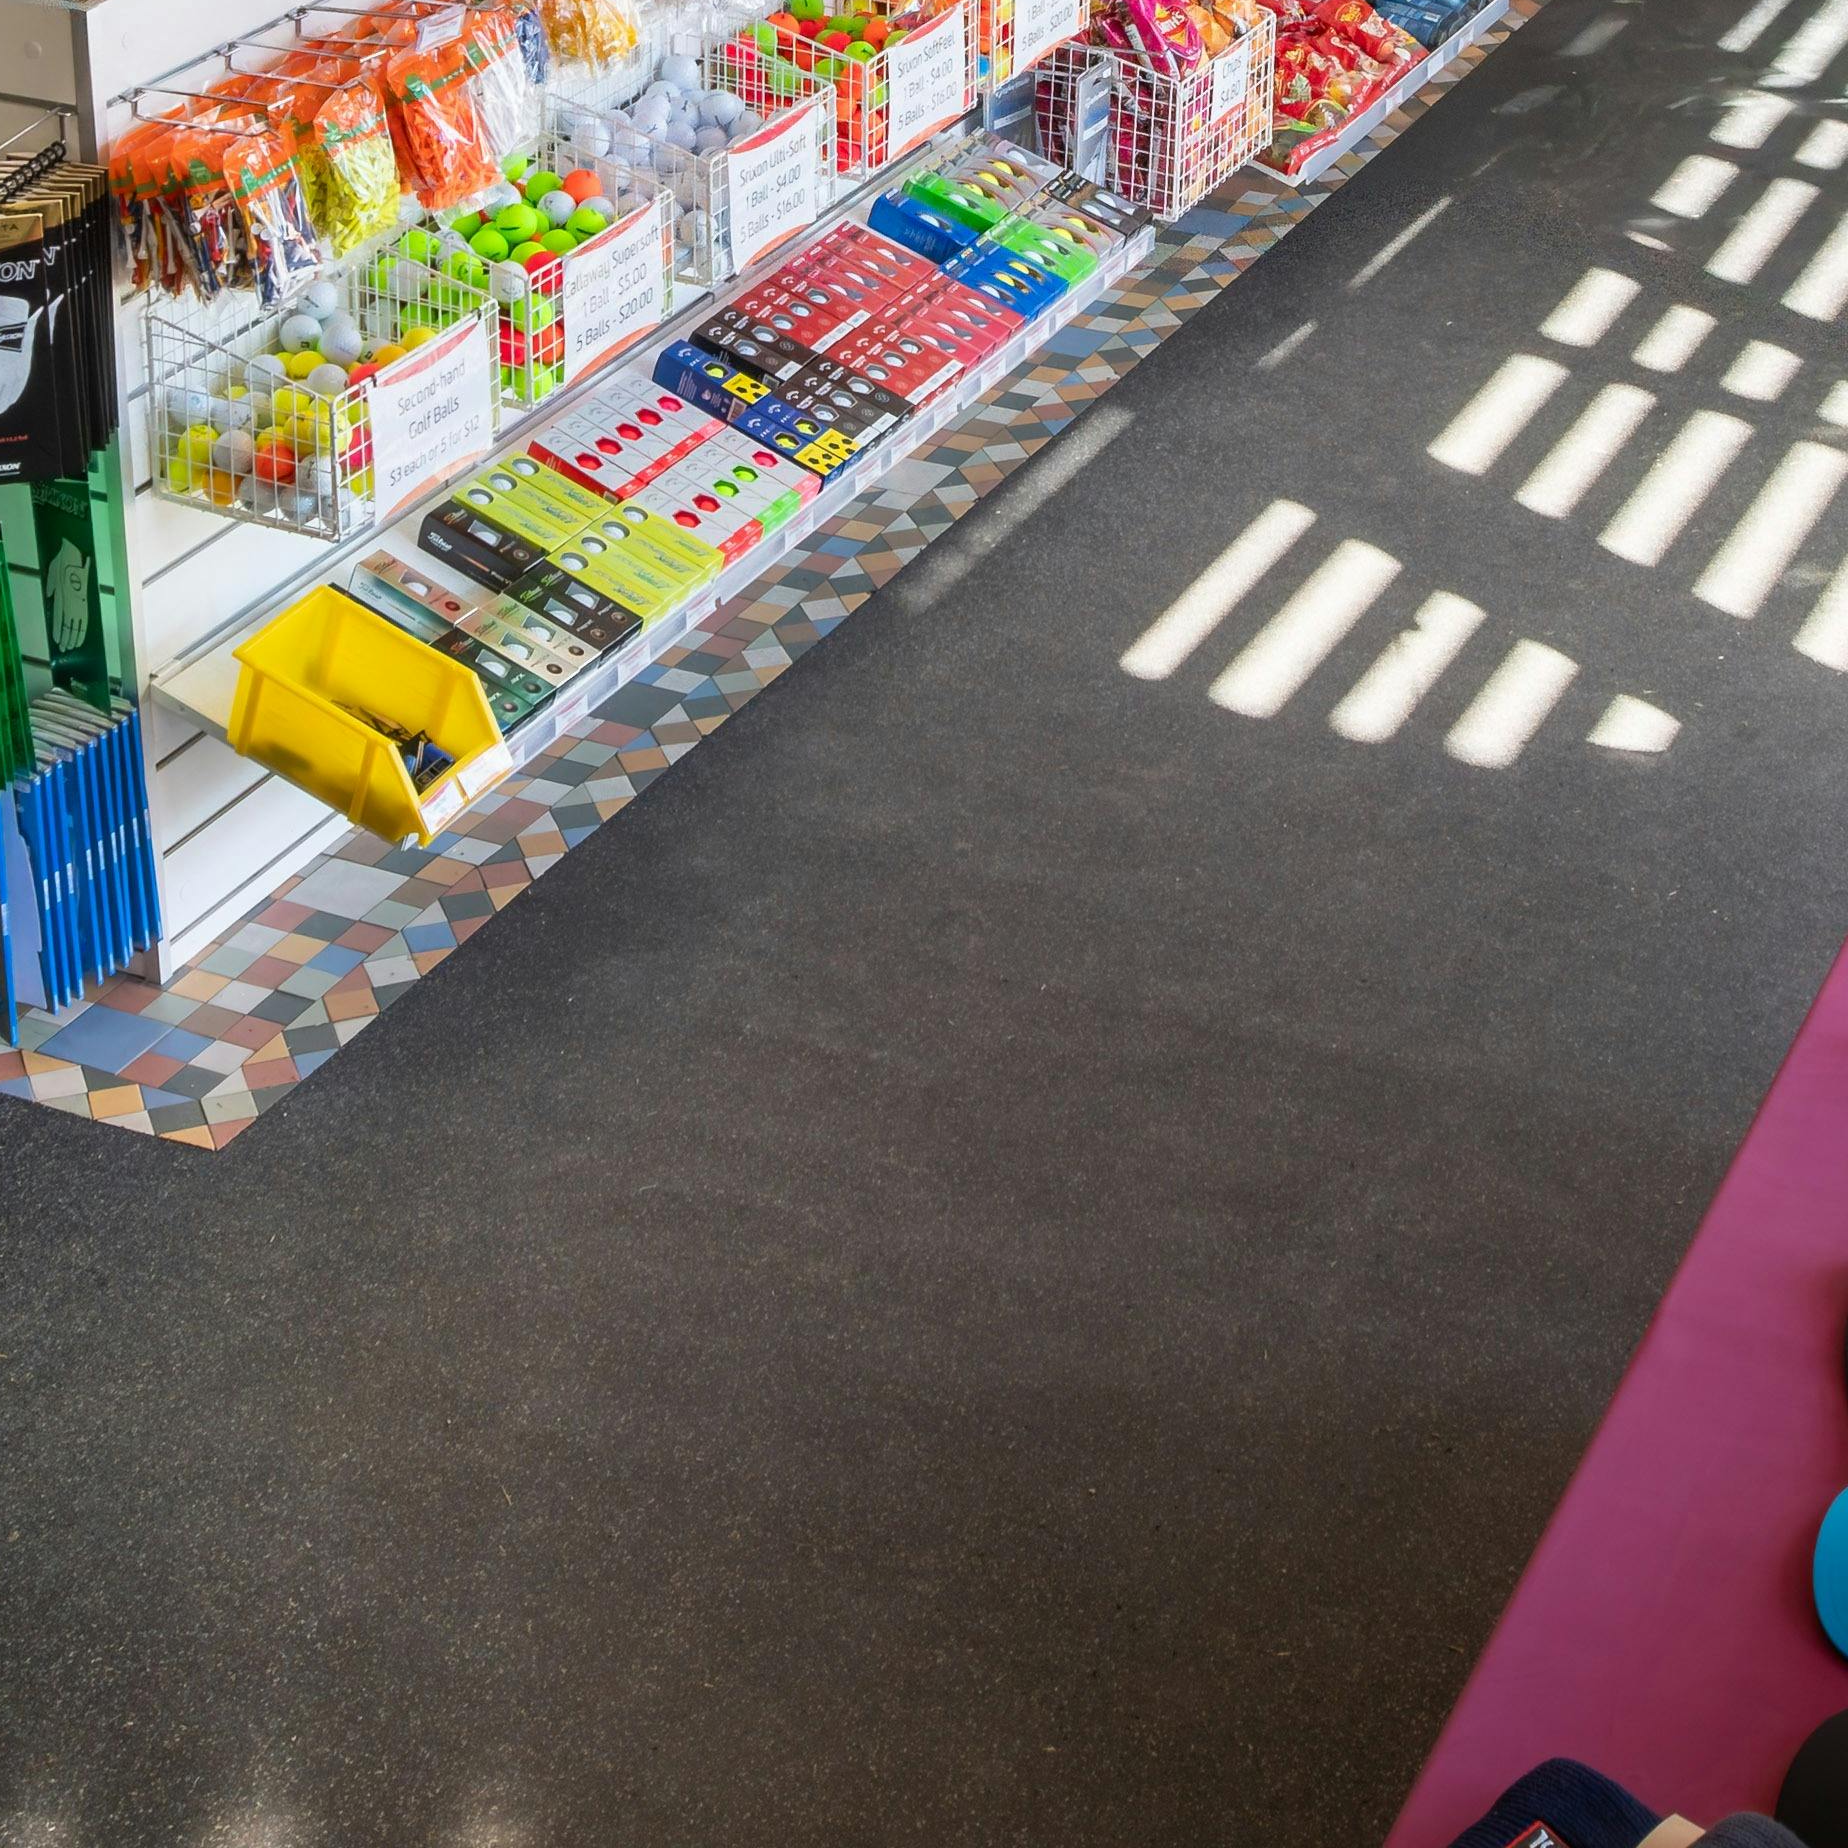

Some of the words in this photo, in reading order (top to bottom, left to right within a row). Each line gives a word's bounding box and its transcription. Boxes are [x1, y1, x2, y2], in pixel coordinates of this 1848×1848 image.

[898, 52, 922, 78] Srixon
[739, 160, 768, 187] Srixon
[752, 184, 769, 208] Ball
[776, 164, 801, 192] $4.00
[777, 188, 805, 220] $16.00
[612, 225, 659, 269] Supersoft
[589, 286, 610, 314] Ball
[618, 262, 647, 296] $5.00
[576, 333, 584, 353] 5
[585, 319, 610, 347] Balls
[619, 287, 654, 325] $20.00
[398, 359, 466, 416] Second-hand
[409, 416, 431, 440] Golf
[434, 395, 460, 424] Balls
[390, 470, 402, 487] $3
[404, 454, 427, 478] each
[428, 445, 440, 462] or
[463, 414, 480, 439] $12
